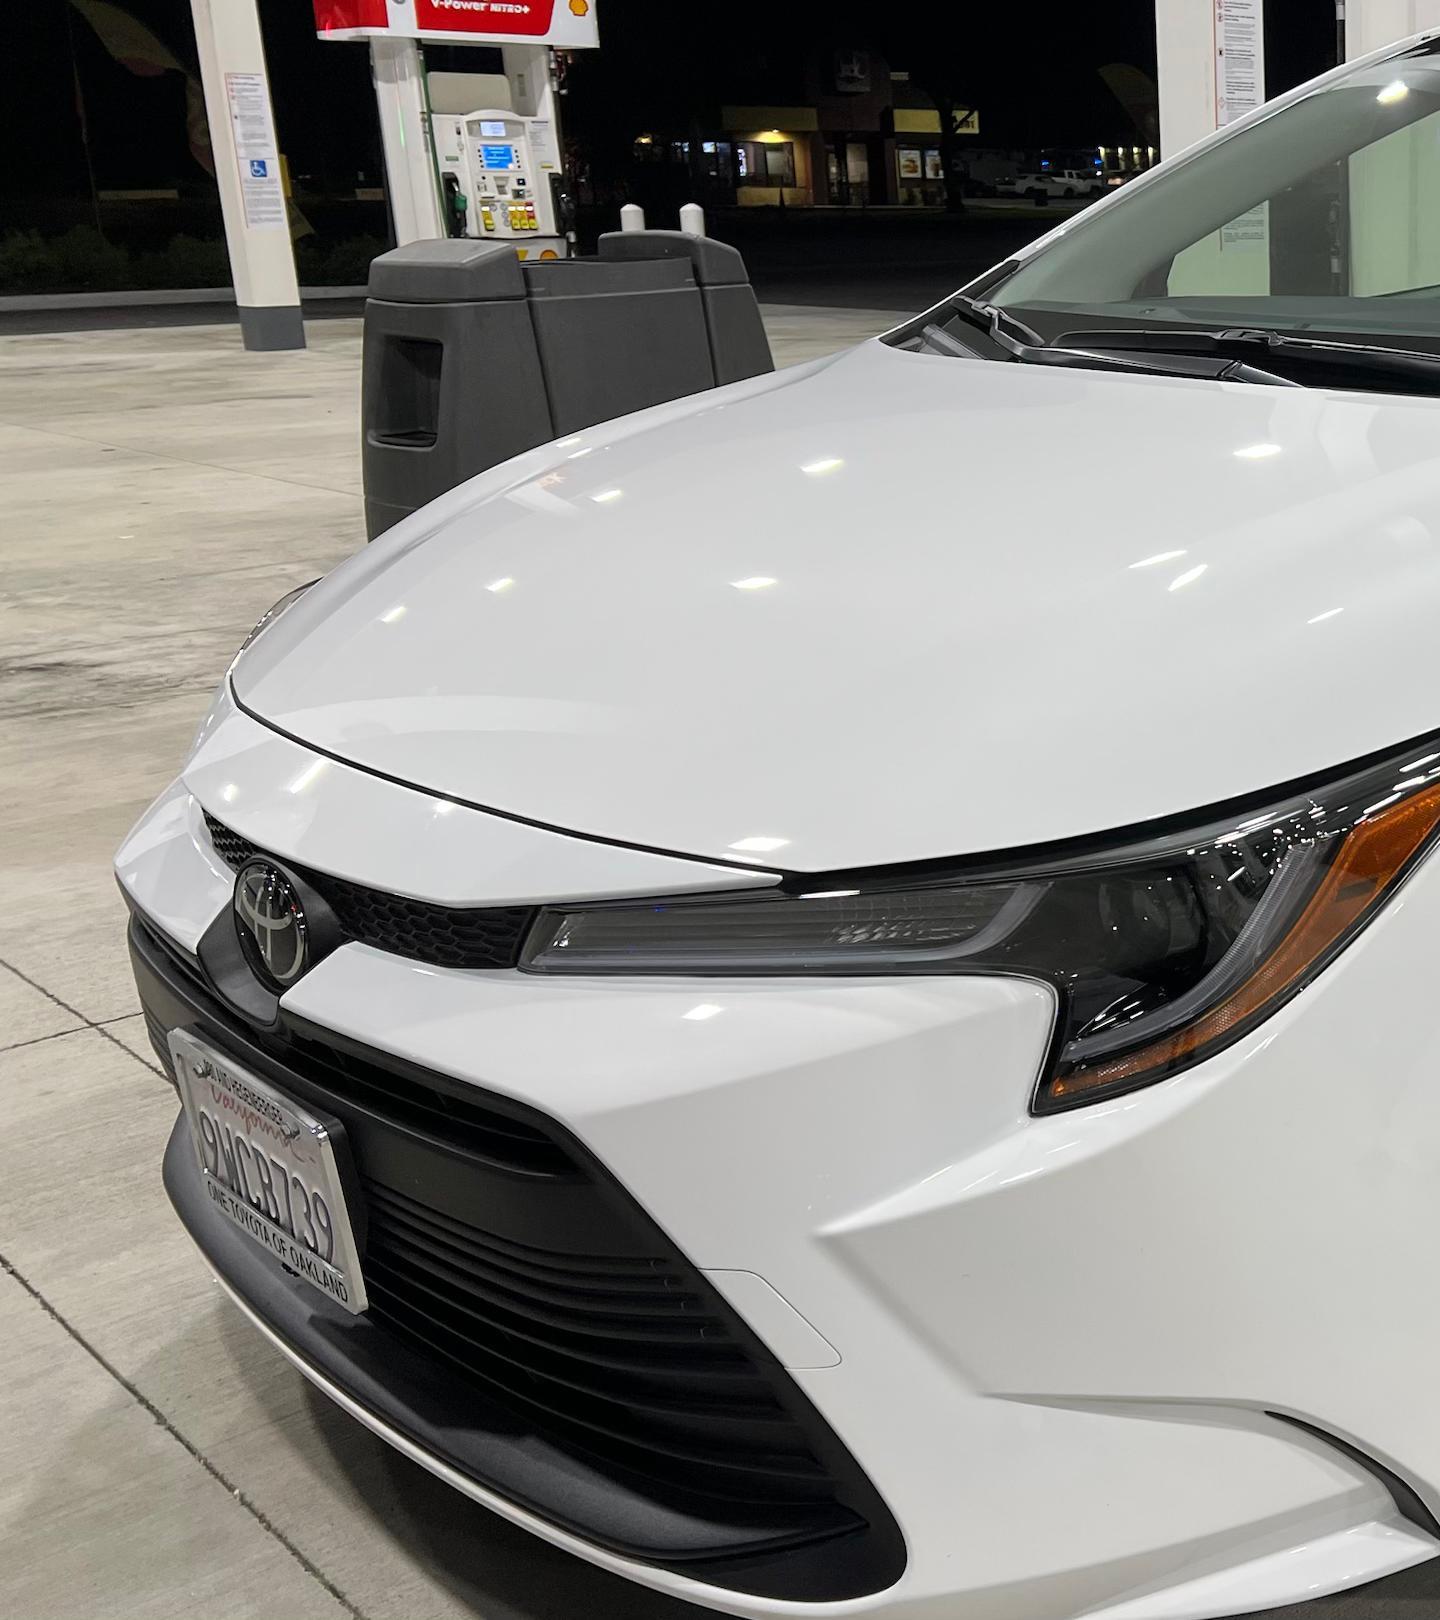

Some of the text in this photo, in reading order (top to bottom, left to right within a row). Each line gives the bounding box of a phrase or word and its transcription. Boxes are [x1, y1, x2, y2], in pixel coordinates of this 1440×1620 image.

[431, 0, 488, 11] V-Power
[199, 1111, 334, 1264] 9WCB739
[207, 1181, 348, 1304] ONE TOYOTA OF OAKLAND
